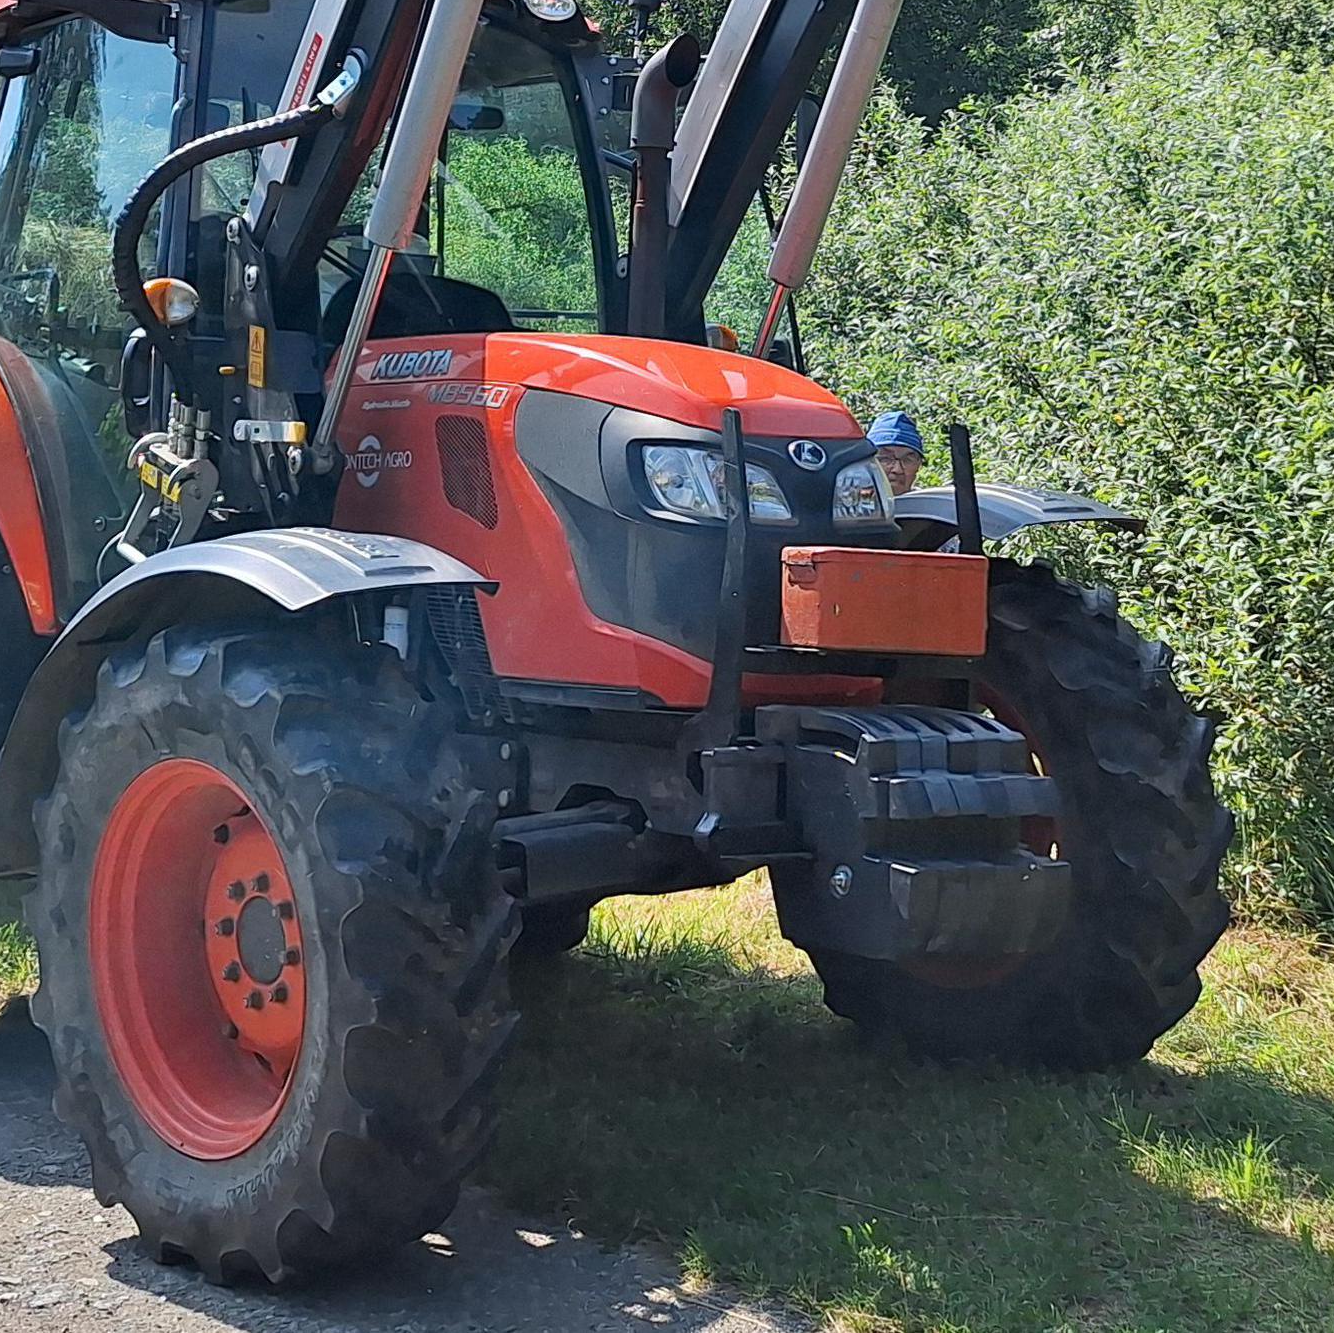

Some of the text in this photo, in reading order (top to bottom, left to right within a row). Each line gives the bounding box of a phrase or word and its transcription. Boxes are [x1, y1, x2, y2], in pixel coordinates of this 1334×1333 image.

[303, 41, 319, 72] LINE
[371, 350, 453, 379] KUBOTA
[384, 451, 412, 467] AGRO
